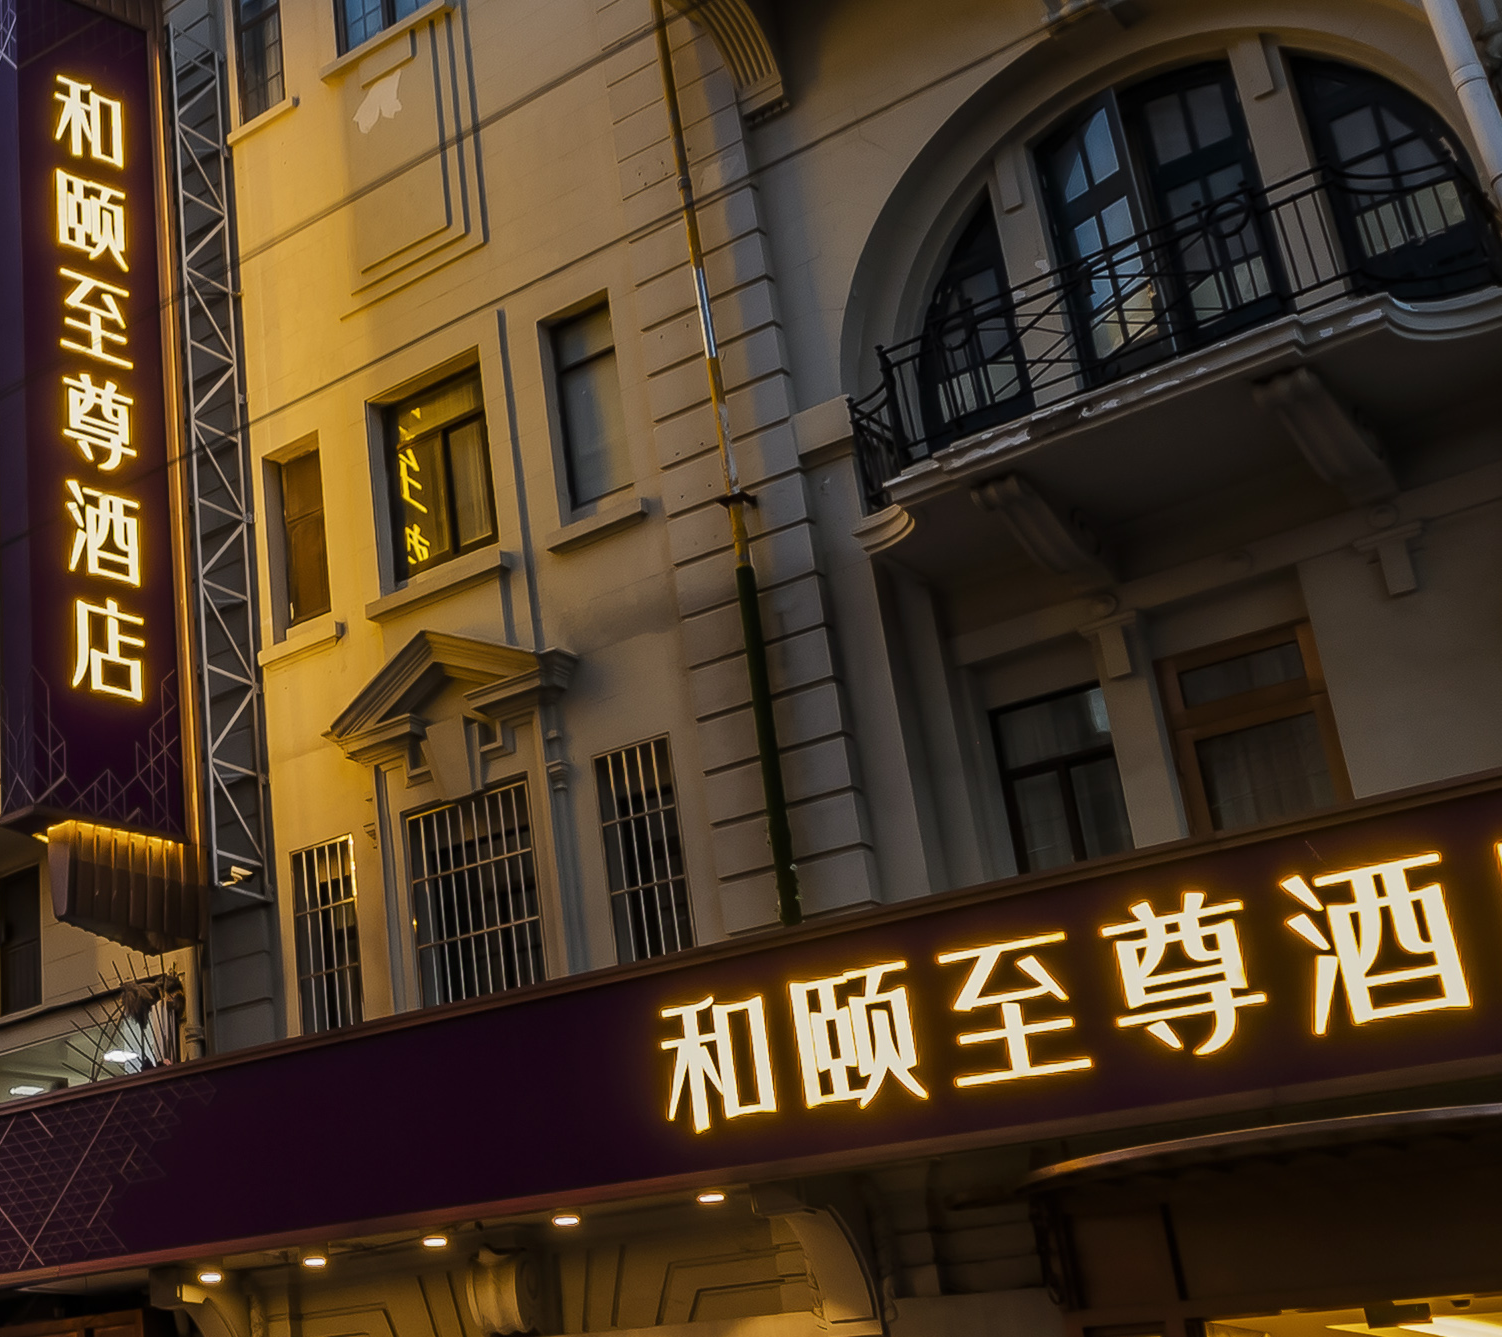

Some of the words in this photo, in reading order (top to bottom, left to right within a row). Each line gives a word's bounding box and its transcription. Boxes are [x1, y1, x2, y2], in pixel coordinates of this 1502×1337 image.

[52, 72, 149, 705] 和颐至尊酒店
